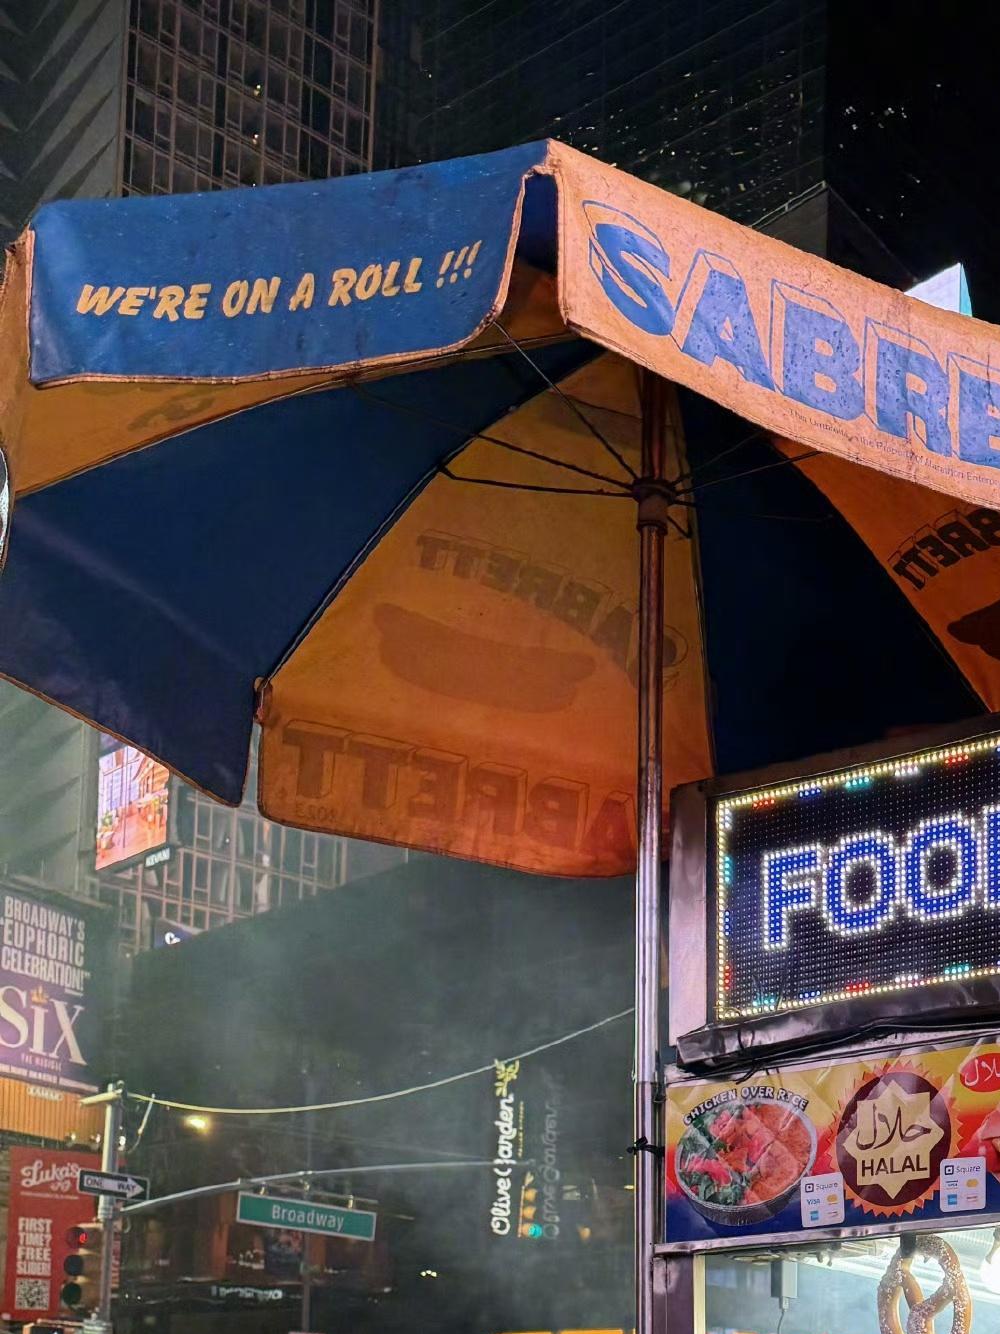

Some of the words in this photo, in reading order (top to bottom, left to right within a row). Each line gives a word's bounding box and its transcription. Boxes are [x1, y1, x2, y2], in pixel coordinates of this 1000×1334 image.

[76, 282, 212, 322] WE'RE
[222, 276, 281, 317] ON
[288, 272, 315, 312] A
[328, 257, 425, 307] ROLL
[436, 239, 482, 289] !!!
[4, 895, 86, 941] BROADWAY'S
[0, 984, 88, 1066] SIX
[683, 1088, 738, 1126] CHICKEN
[740, 1086, 775, 1100] OVER
[777, 1088, 810, 1112] RICE
[853, 1101, 932, 1150] حلال
[21, 1160, 80, 1188] Luka's
[859, 1152, 928, 1176] HALAL
[956, 1164, 981, 1175] Square
[85, 1176, 104, 1188] ONE
[117, 1182, 137, 1193] WAY
[816, 1182, 839, 1192] Square
[271, 1203, 345, 1233] Broadway
[490, 1177, 512, 1237] Olive
[18, 1217, 52, 1233] FIRST
[16, 1248, 51, 1262] FREE
